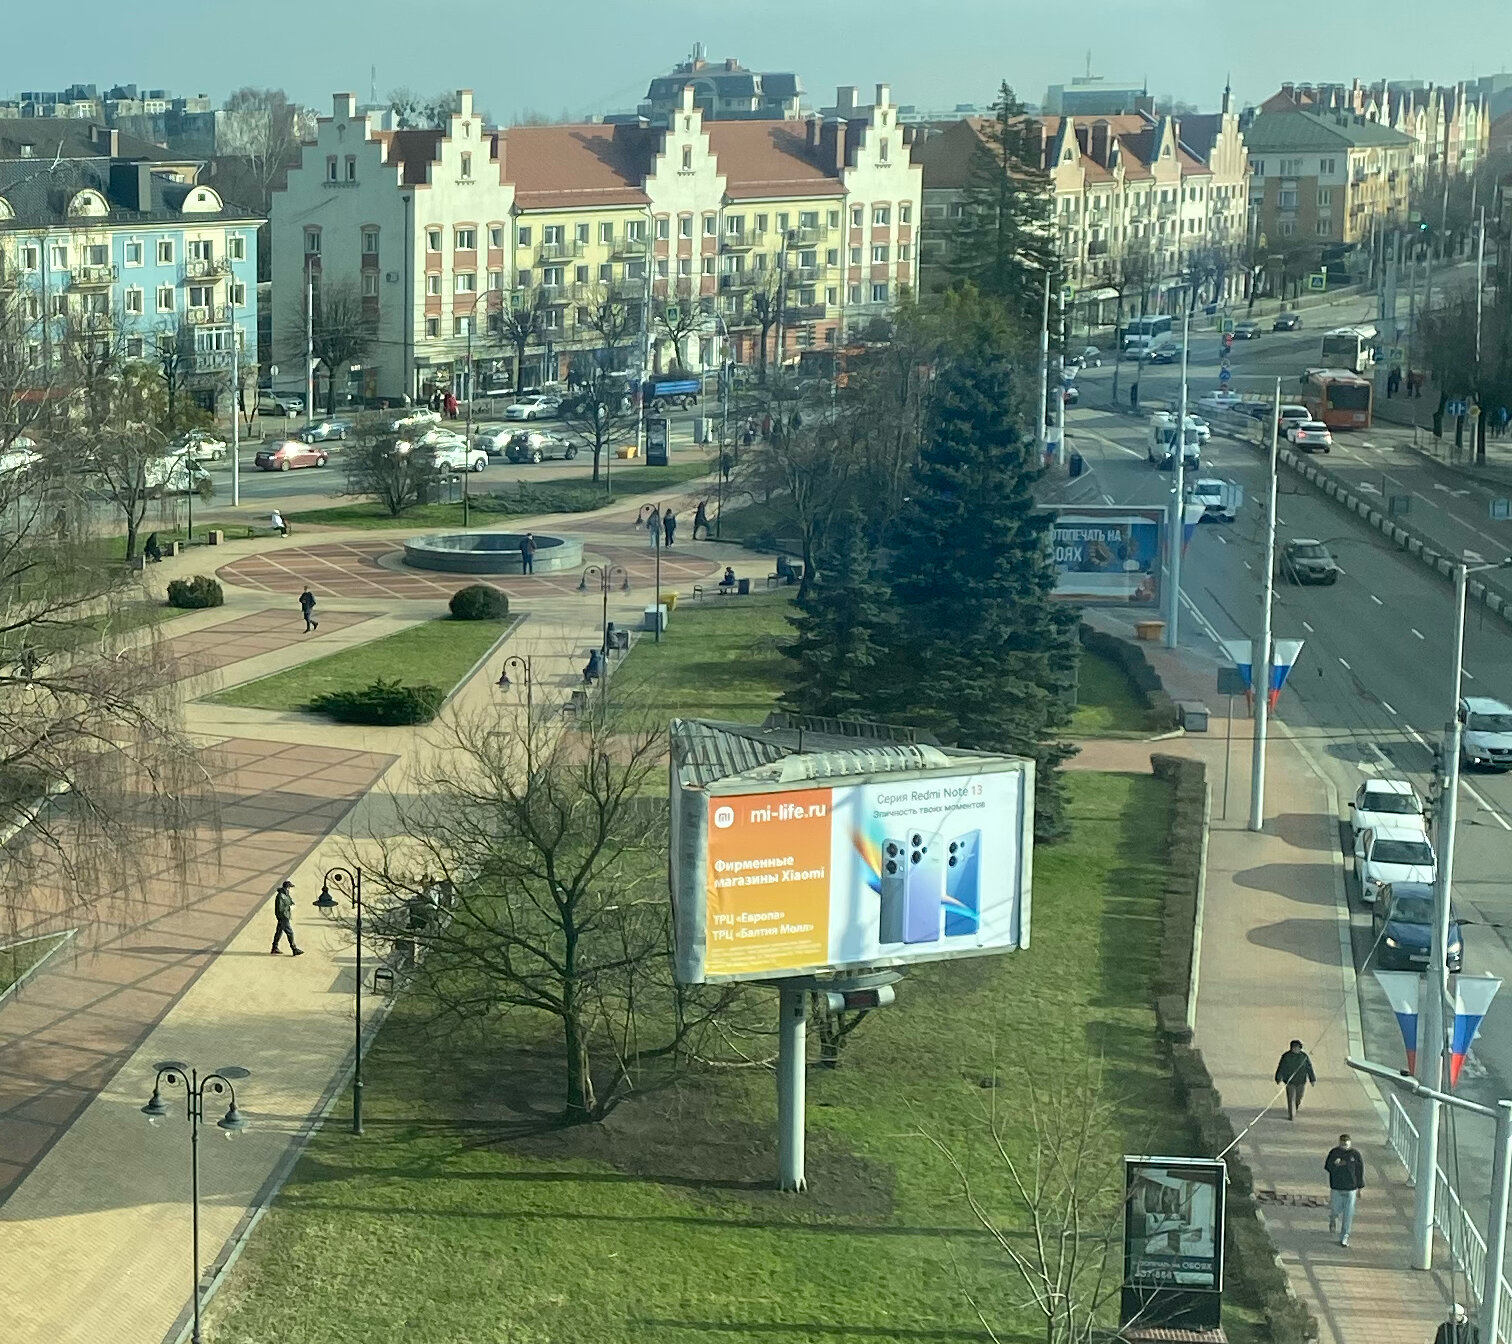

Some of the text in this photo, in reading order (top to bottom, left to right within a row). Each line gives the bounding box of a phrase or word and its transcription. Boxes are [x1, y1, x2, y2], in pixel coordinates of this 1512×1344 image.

[1050, 528, 1122, 542] ОТОПЕЧАТЬ НА
[1055, 546, 1082, 562] ОЯХ
[877, 784, 983, 805] Серия Redmi Note 13
[750, 803, 827, 823] mi-life.ru
[714, 856, 795, 873] Фирменные
[714, 866, 825, 889] магазины Xiaomi
[712, 911, 785, 926] ТРЦ «Европа»
[712, 923, 815, 942] ТРЦ «Балтия Молл»
